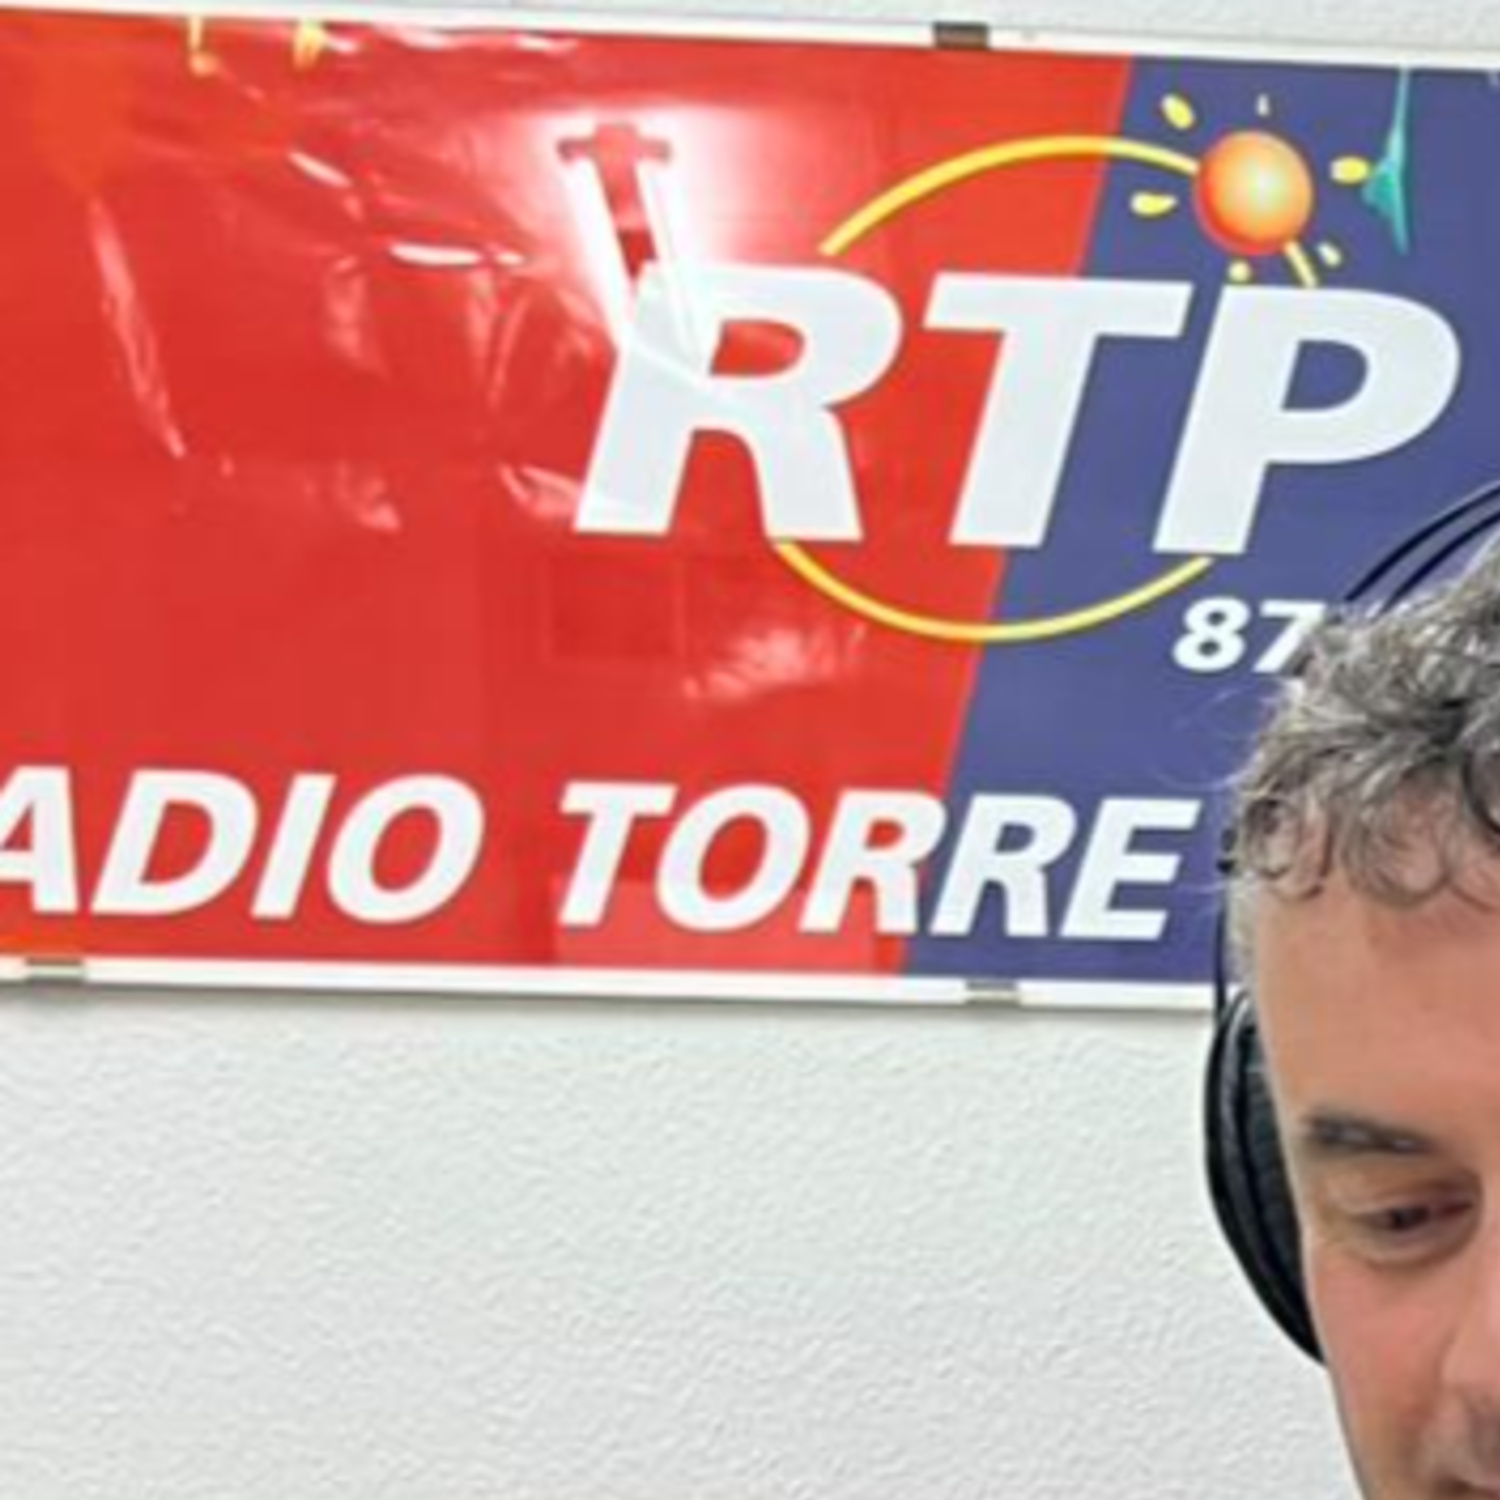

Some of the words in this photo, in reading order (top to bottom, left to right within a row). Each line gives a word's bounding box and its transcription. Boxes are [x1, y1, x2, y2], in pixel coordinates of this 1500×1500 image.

[572, 260, 1461, 555] RTP
[0, 766, 483, 923] ADIO
[560, 781, 1201, 940] TORRE
